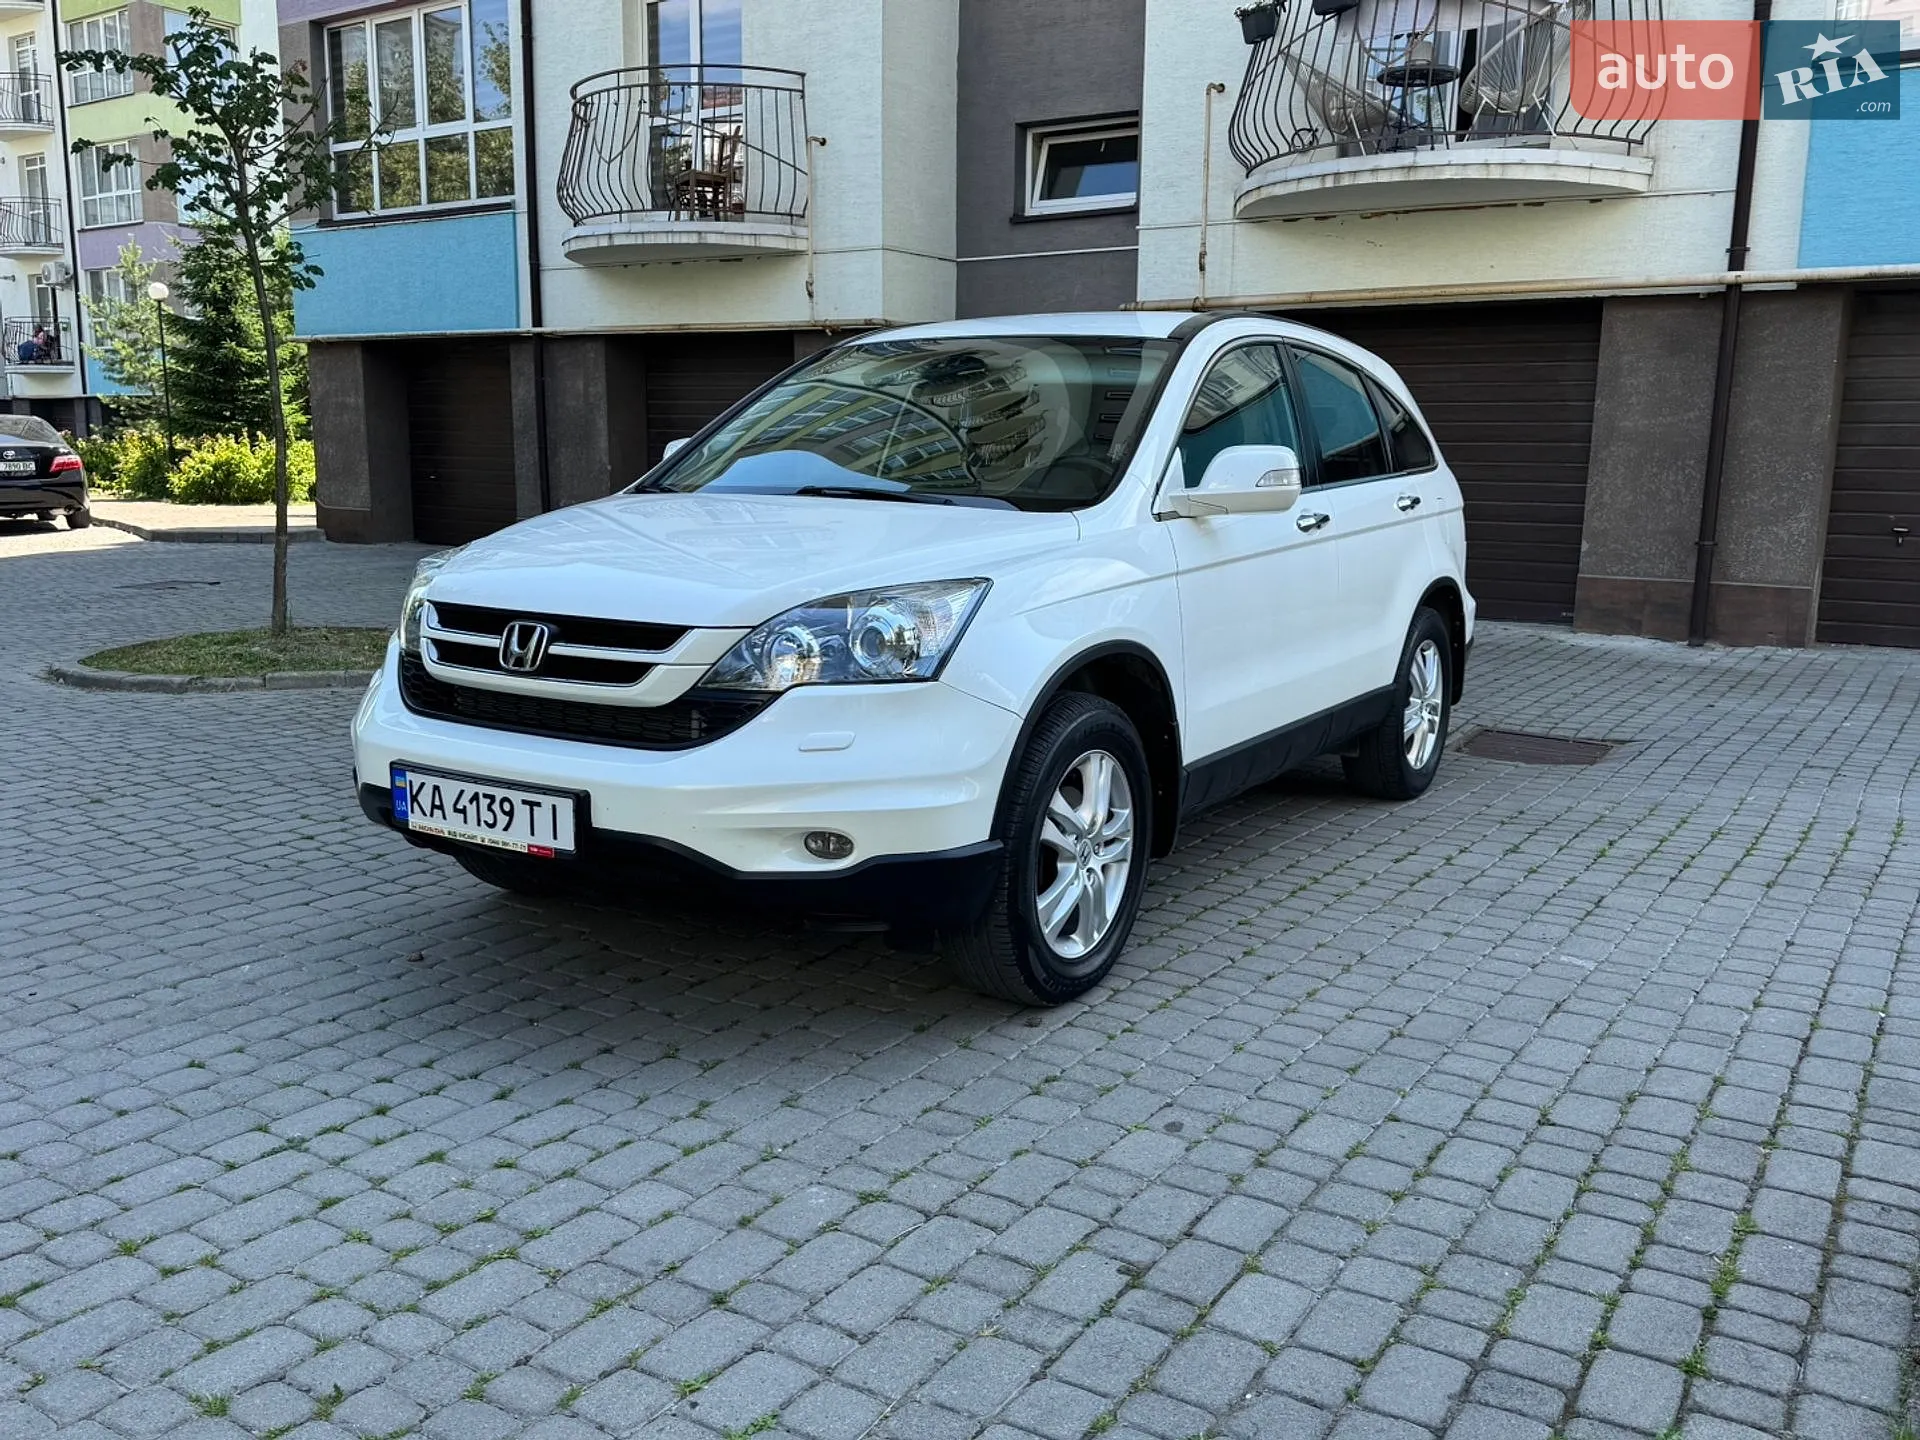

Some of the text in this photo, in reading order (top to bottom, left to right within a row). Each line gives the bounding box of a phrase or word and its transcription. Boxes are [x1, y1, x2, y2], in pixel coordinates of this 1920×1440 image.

[395, 799, 408, 812] UA
[408, 779, 558, 841] KA 4139 TI
